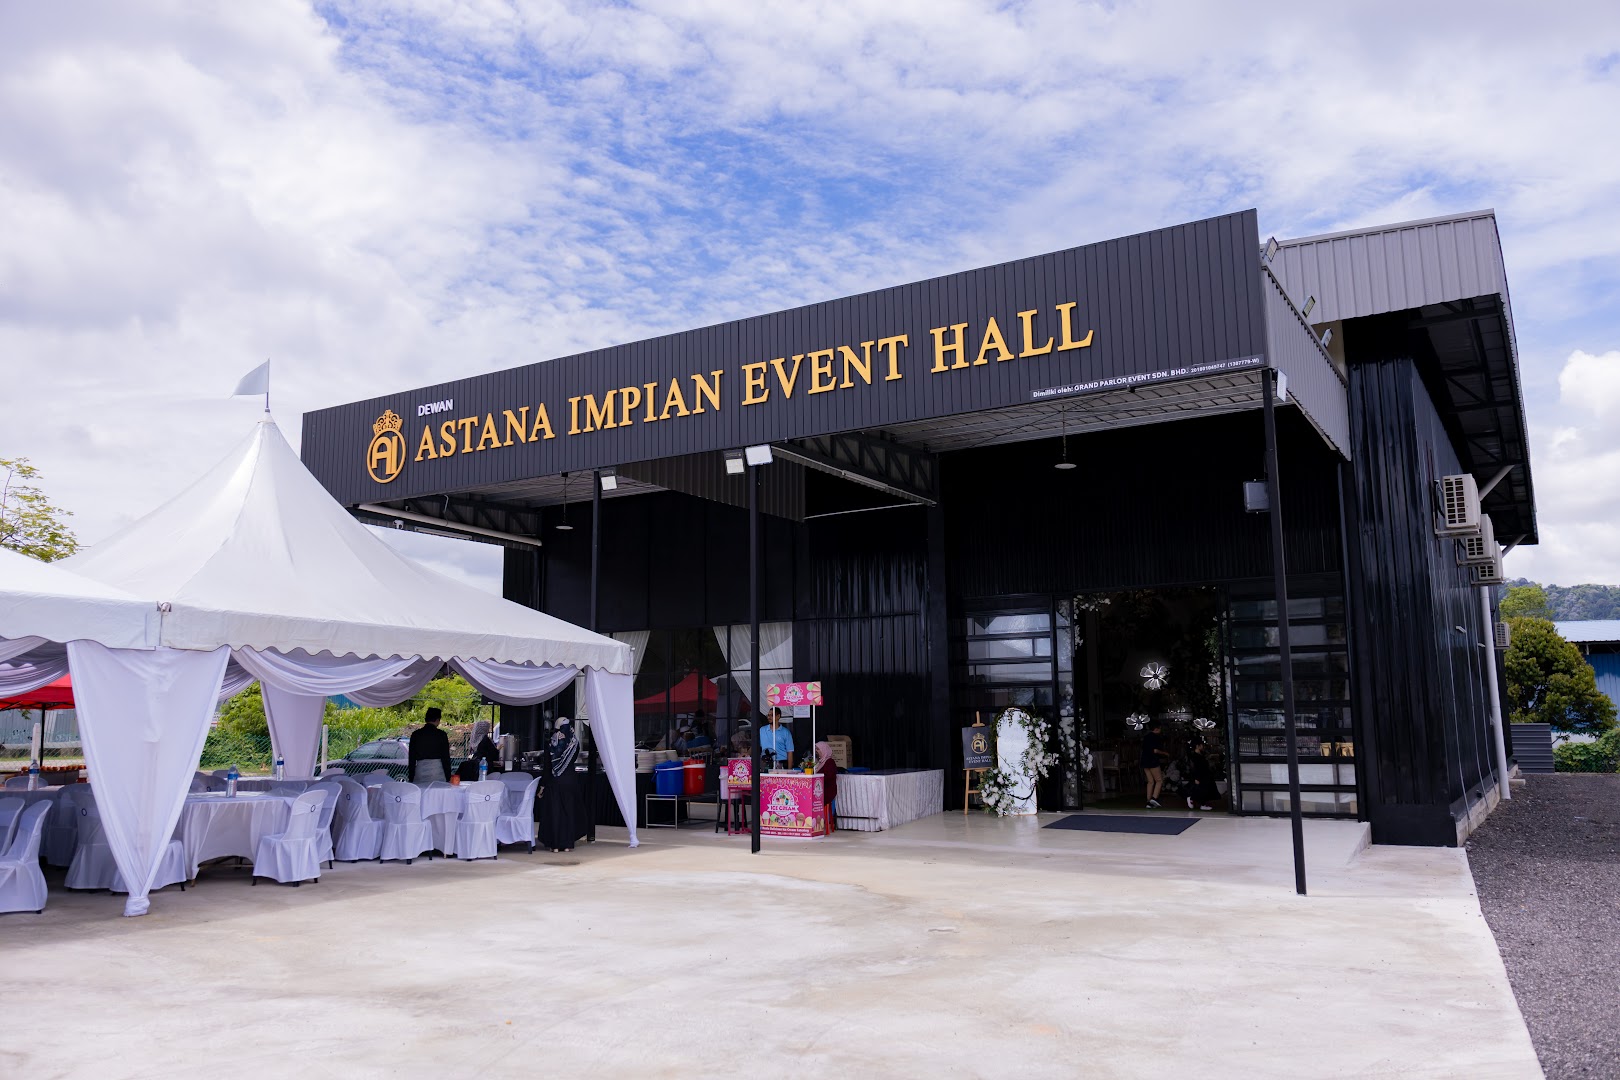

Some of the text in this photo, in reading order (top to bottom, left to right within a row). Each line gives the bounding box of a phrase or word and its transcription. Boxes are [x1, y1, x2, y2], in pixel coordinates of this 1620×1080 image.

[415, 302, 1094, 462] ASTANA IMPIAN EVENT HALL
[1074, 381, 1099, 391] GRAND
[1099, 377, 1127, 387] PARLOR
[1127, 374, 1151, 383] EVENT
[1151, 371, 1170, 379] SDN.
[1170, 368, 1189, 376] BHD.
[417, 398, 454, 417] DEWAN
